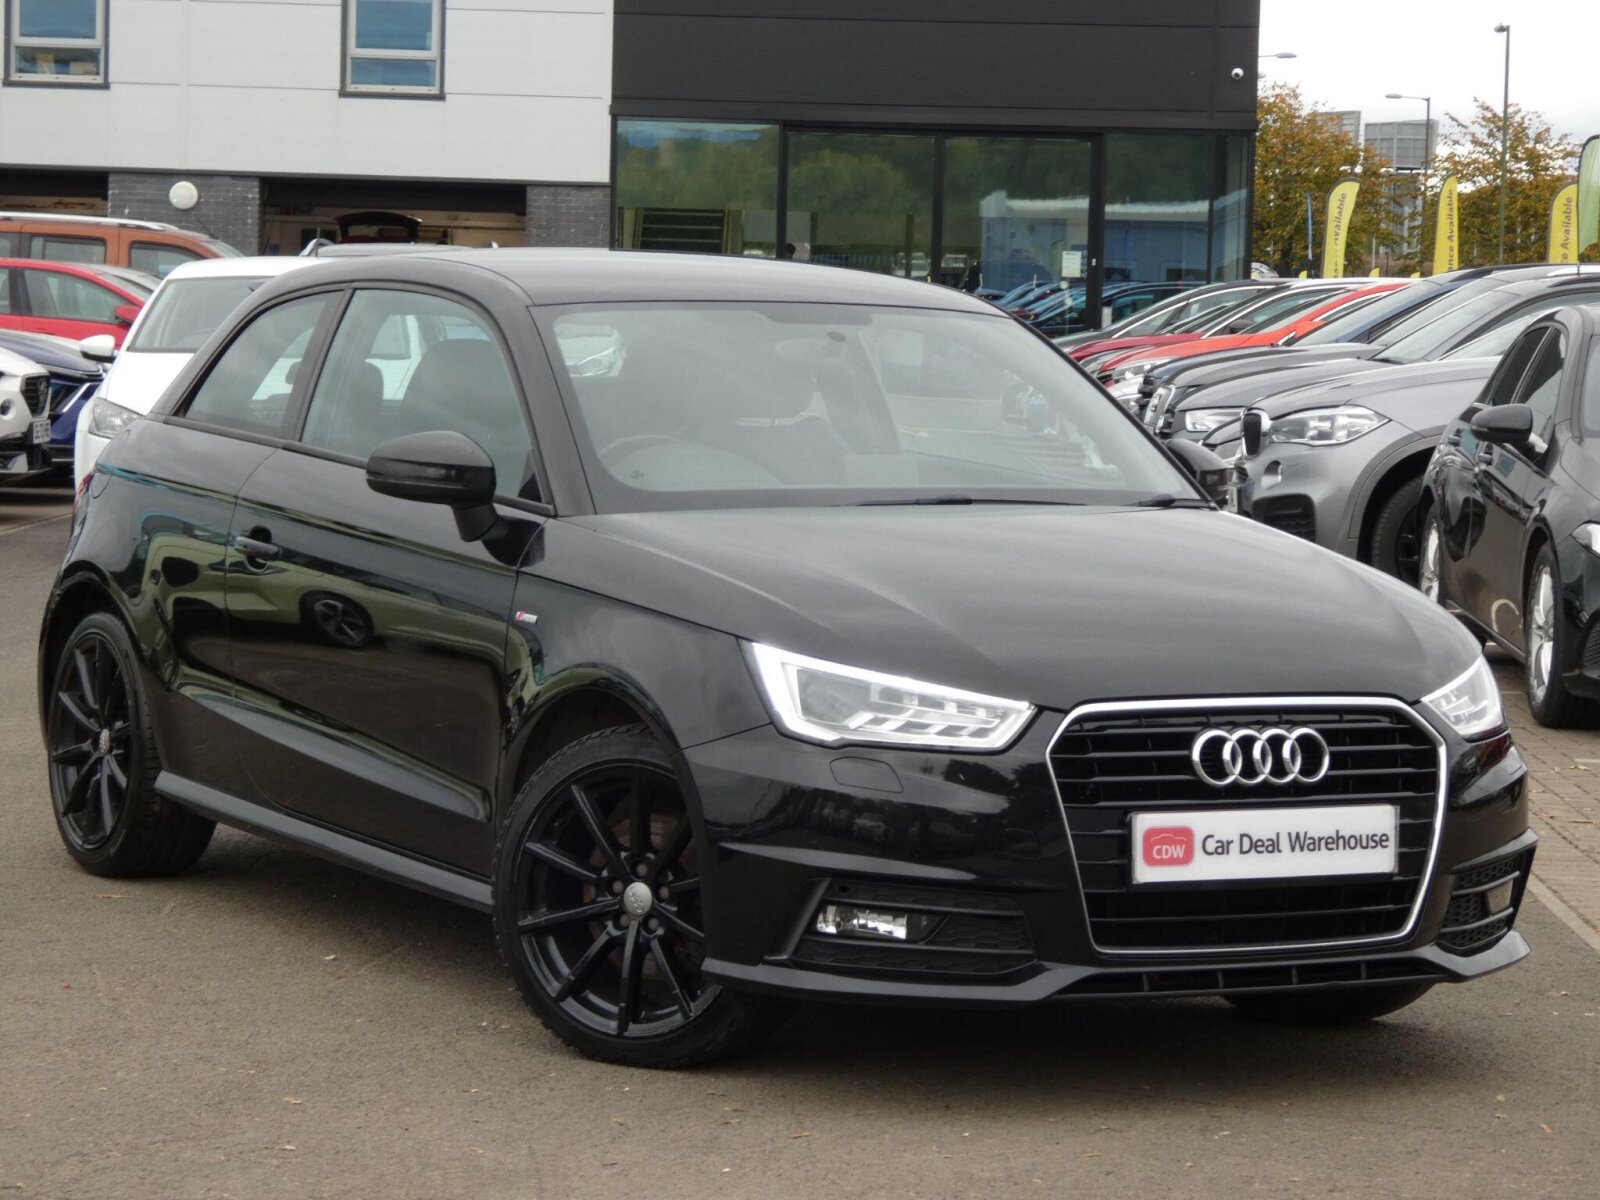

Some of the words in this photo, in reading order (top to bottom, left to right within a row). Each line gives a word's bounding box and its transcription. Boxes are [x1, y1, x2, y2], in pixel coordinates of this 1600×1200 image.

[1446, 189, 1455, 243] Available
[1561, 196, 1573, 251] Available
[1152, 844, 1186, 860] CDW
[1202, 834, 1234, 856] Car
[1239, 832, 1283, 855] Deal
[1287, 829, 1390, 853] Warehouse
